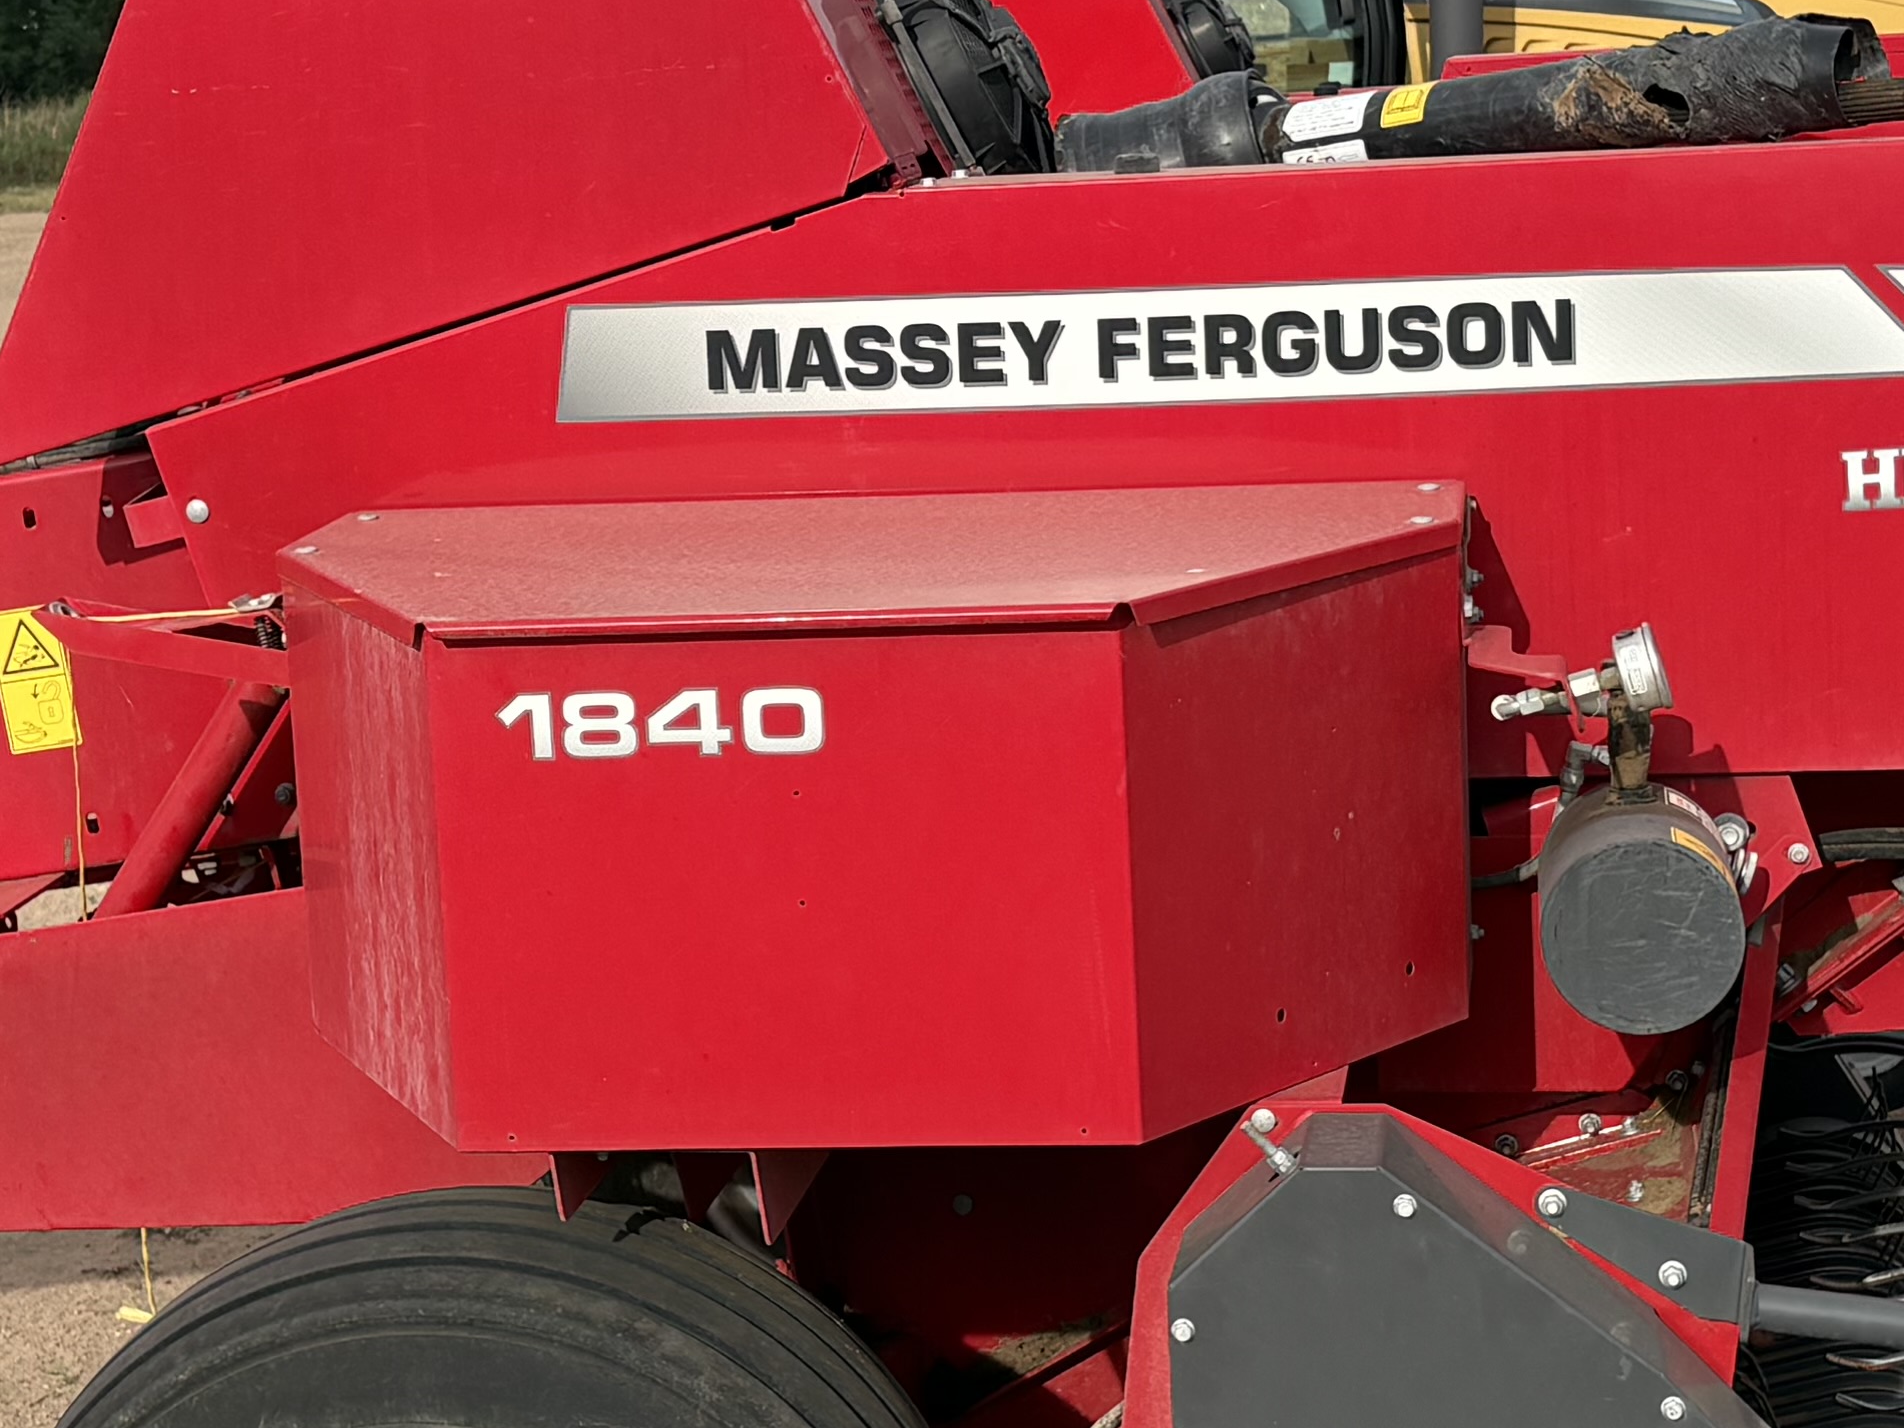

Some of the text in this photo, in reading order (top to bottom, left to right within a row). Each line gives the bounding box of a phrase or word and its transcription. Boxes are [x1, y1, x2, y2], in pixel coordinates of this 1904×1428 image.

[706, 298, 1577, 394] MASSEY FERGUSON
[495, 685, 826, 760] 1840
